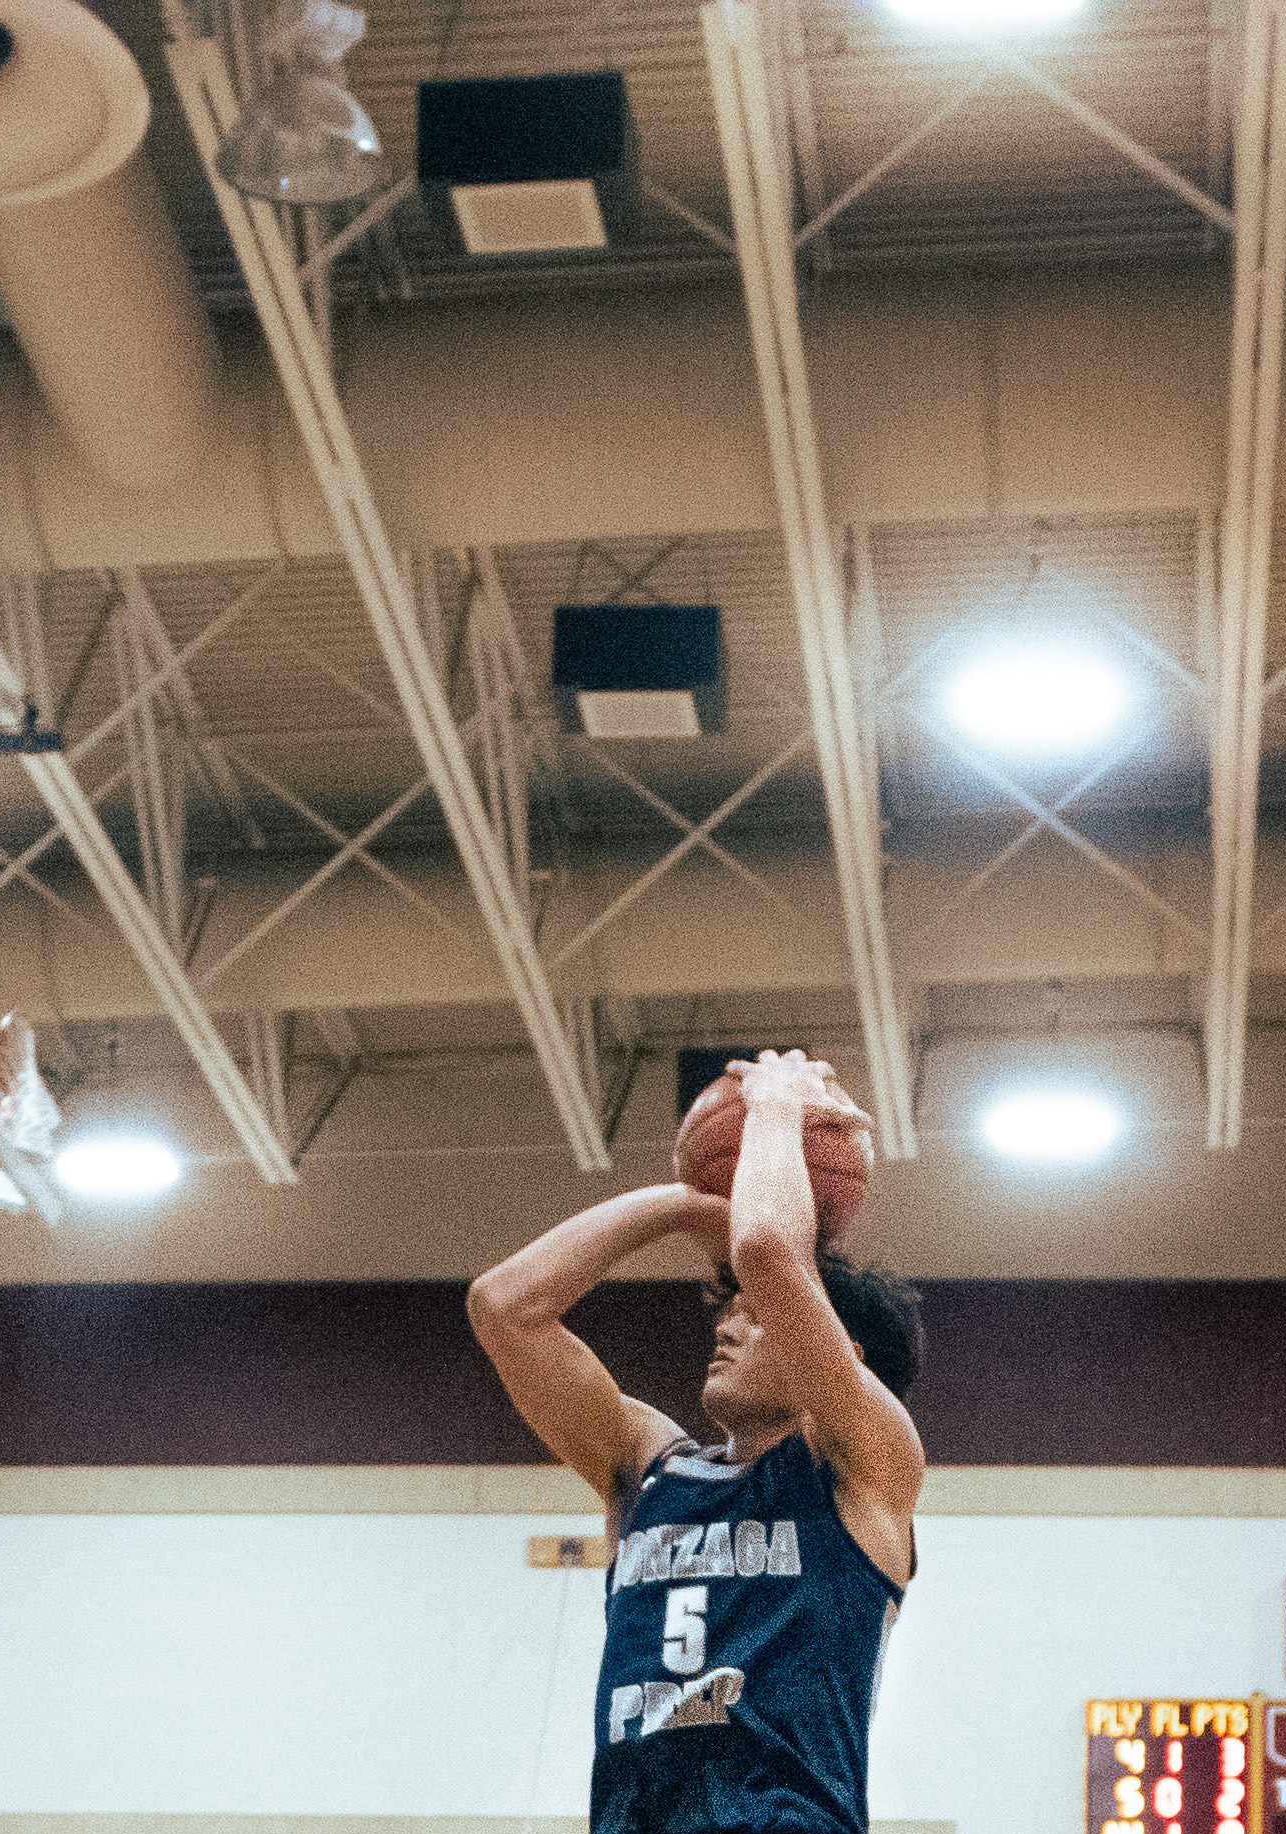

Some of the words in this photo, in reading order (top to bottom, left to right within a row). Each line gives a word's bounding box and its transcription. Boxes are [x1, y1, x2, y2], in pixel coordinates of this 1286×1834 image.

[612, 1519, 803, 1596] ONZAGA
[662, 1584, 710, 1676] 5
[1090, 1703, 1143, 1738] PLY
[1150, 1703, 1190, 1738] FL
[1190, 1703, 1250, 1738] PTS
[1115, 1738, 1146, 1774] 4
[1165, 1738, 1183, 1774] 1
[1152, 1775, 1184, 1819] 0
[1214, 1776, 1246, 1819] 2
